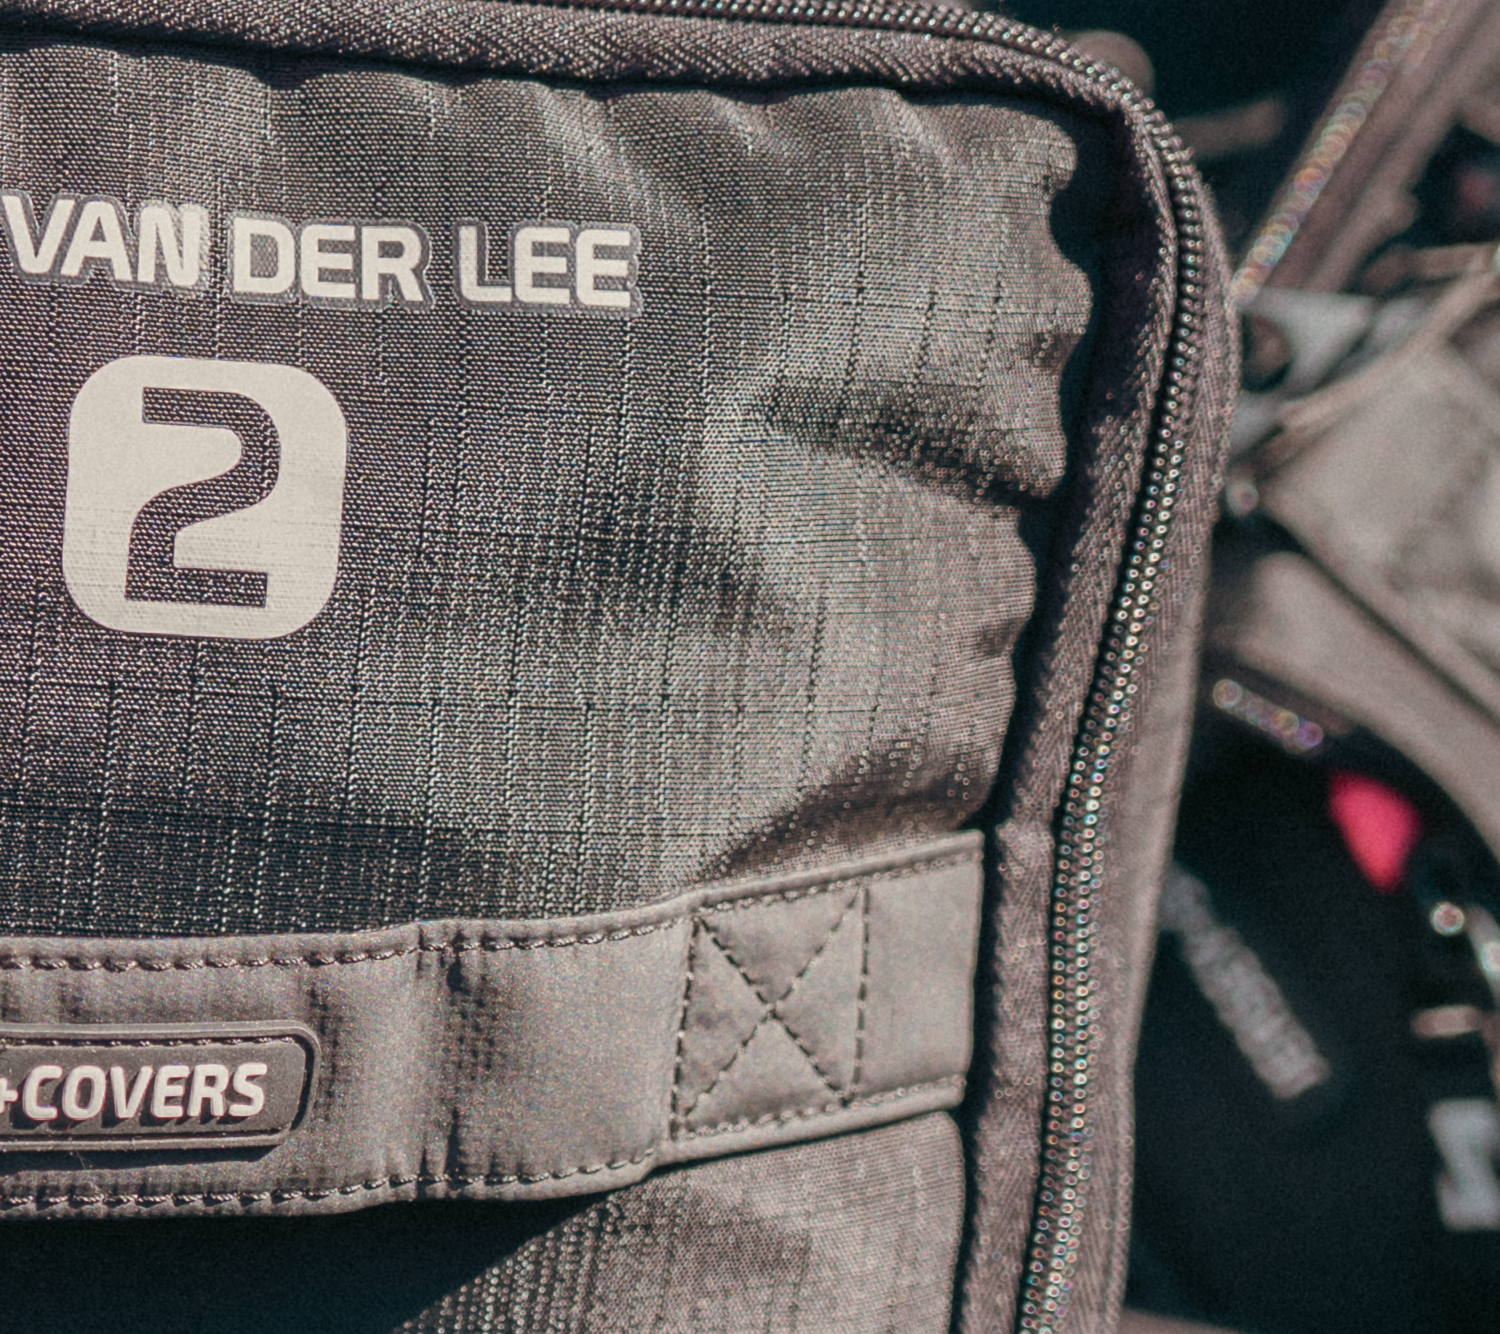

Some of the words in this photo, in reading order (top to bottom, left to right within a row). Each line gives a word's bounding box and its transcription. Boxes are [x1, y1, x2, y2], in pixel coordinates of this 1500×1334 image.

[0, 192, 207, 286] VAN
[232, 214, 428, 305] DER
[457, 223, 634, 308] LEE
[124, 385, 283, 609] 2
